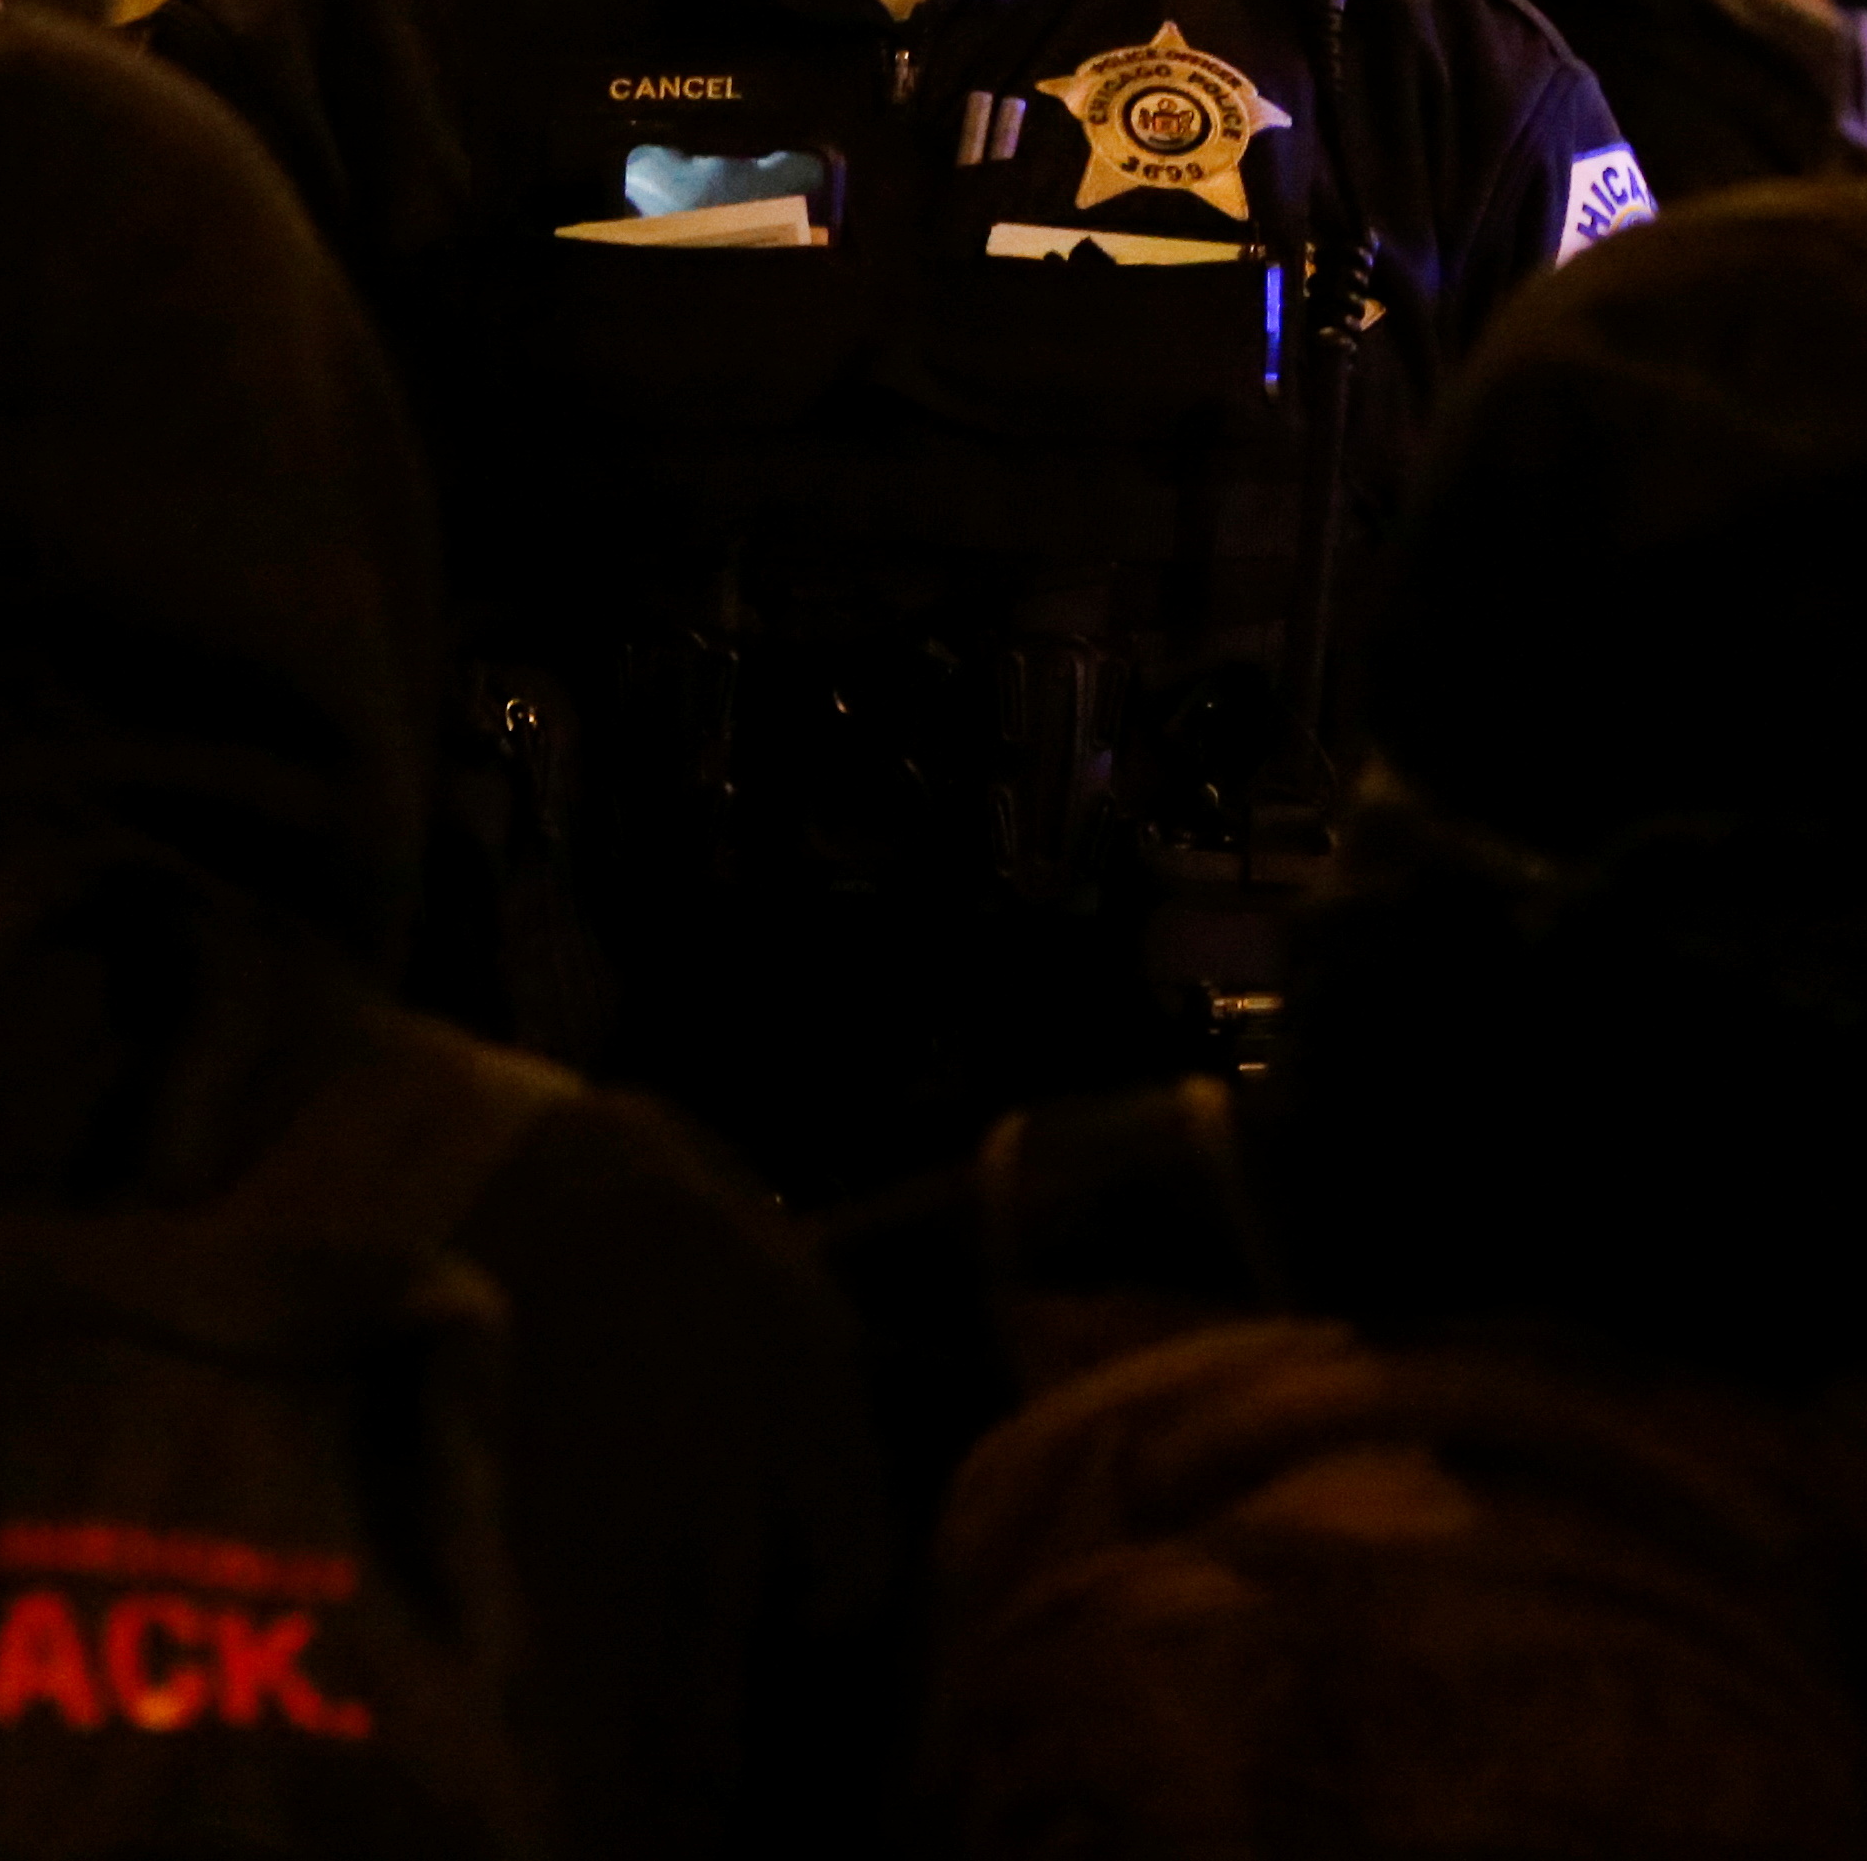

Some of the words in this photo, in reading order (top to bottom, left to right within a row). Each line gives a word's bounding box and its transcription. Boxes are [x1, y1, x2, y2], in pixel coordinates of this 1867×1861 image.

[608, 74, 744, 101] CANCEL
[1088, 63, 1172, 126] CHICAGO
[1187, 70, 1243, 141] POLICE
